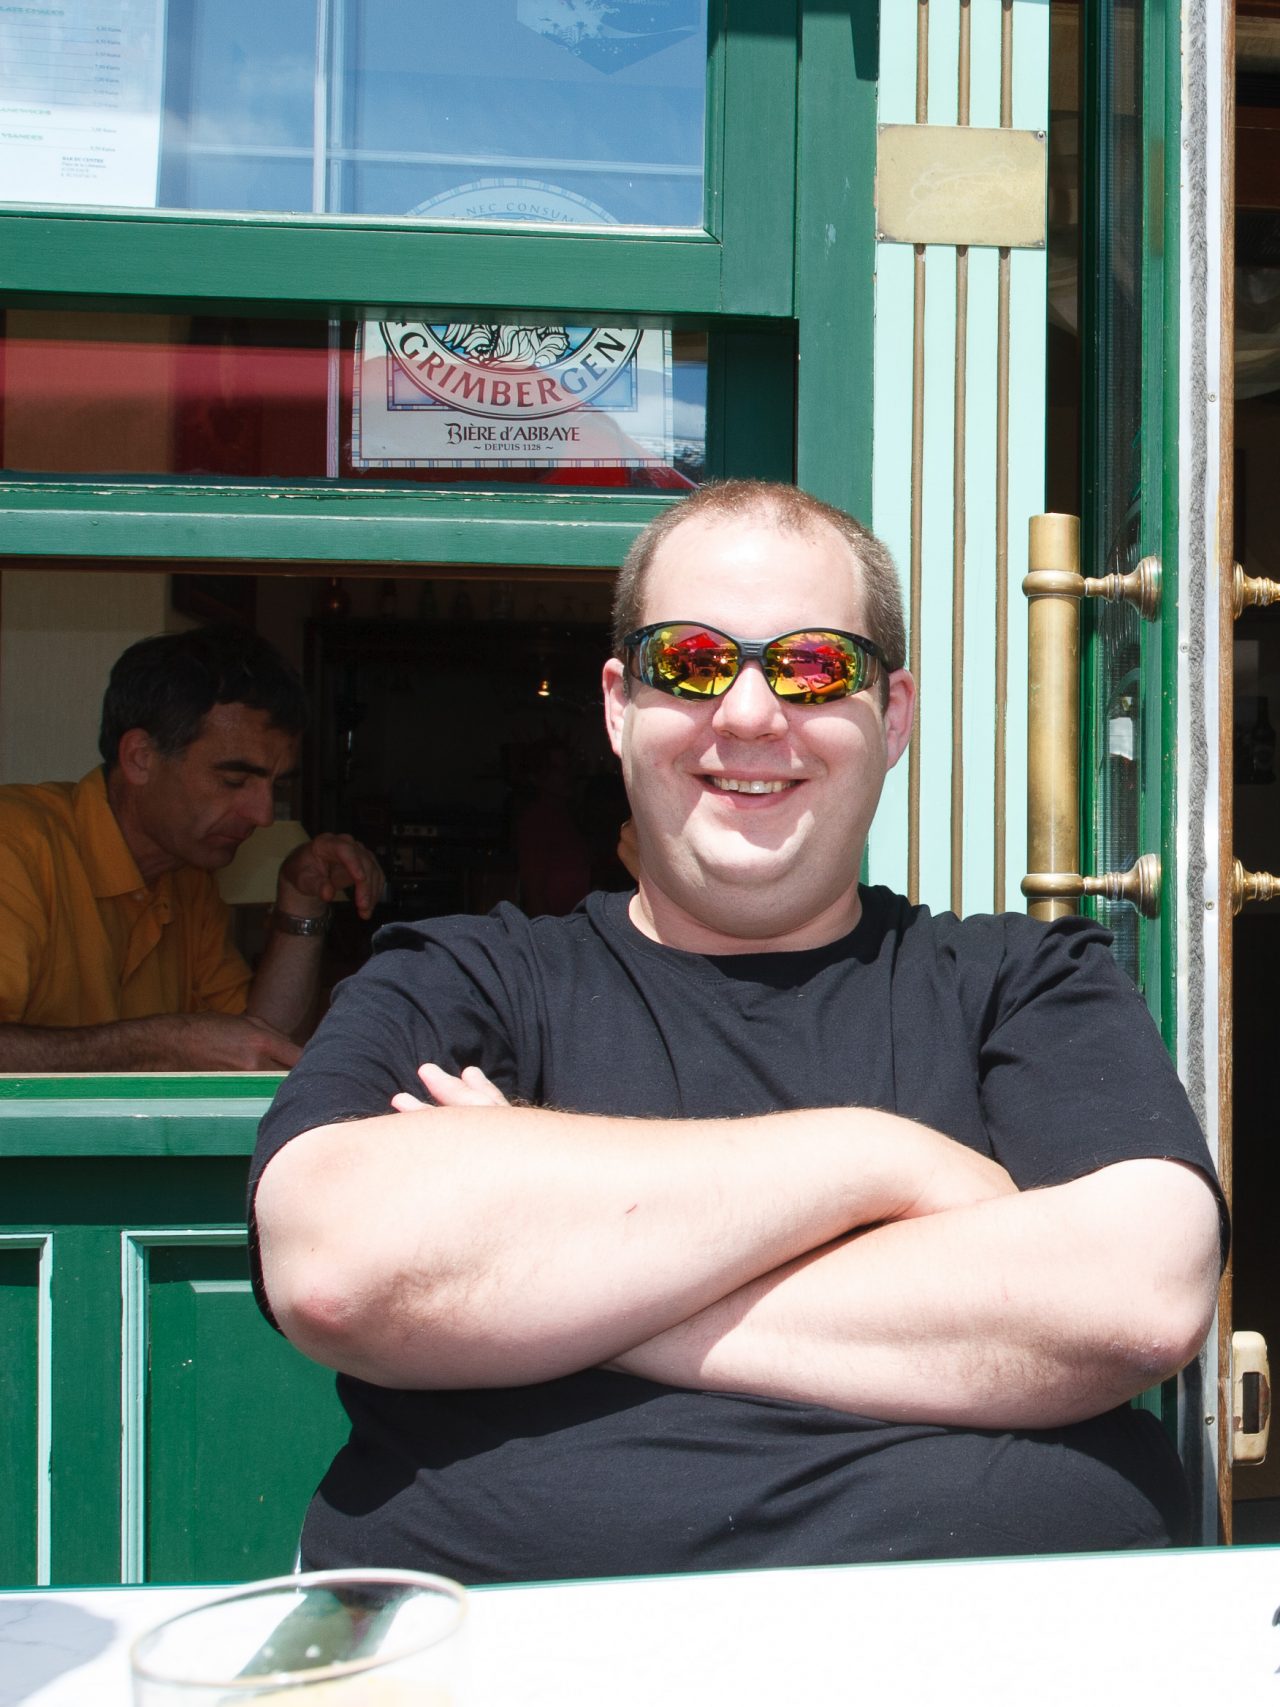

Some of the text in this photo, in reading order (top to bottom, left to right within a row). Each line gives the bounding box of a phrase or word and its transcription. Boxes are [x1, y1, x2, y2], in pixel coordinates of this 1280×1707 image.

[466, 202, 496, 216] NEC
[398, 330, 627, 409] GRIMBERGEN
[444, 422, 496, 445] BIÈRE
[484, 443, 541, 451] DEPUIS 1128
